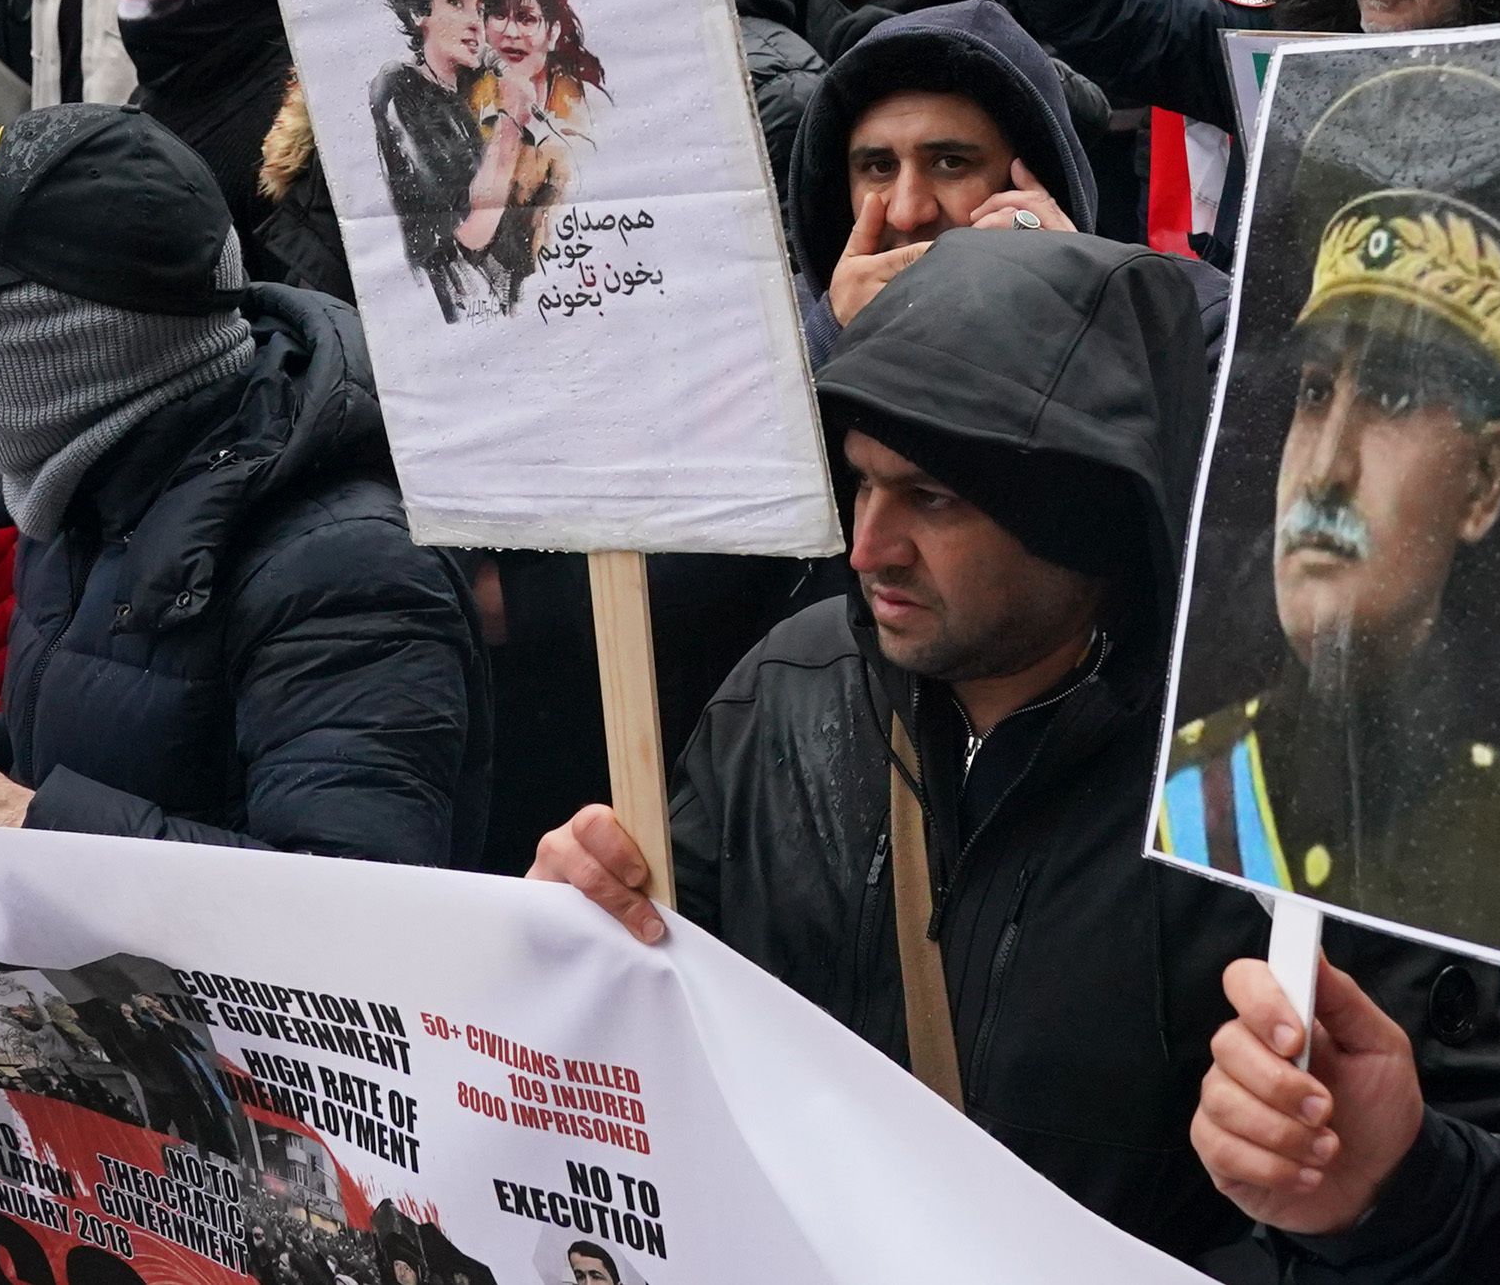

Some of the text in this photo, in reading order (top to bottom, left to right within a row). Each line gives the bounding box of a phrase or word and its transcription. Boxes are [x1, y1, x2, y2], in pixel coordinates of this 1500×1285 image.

[537, 234, 593, 277] خوبم
[578, 261, 665, 296] بخون تا
[537, 284, 604, 326] بخونم
[160, 990, 412, 1076] THE GOVERNMENT
[174, 967, 407, 1038] CORRUPTION IN
[240, 1046, 418, 1134] HIGH RATE OF
[420, 1011, 641, 1096] 50+ CIVILIANS KILLED
[220, 1068, 420, 1174] UNEMPLOYMENT
[457, 1081, 651, 1156] 8000 IMPRISONED
[508, 1073, 647, 1126] 109 INJURED
[97, 1153, 247, 1242] THEOCRATIC
[164, 1143, 242, 1206] NO TO
[564, 1159, 661, 1219] NO TO
[71, 1209, 136, 1260] 2018
[95, 1182, 249, 1278] GOVERNMENT
[492, 1178, 668, 1260] EXECUTION
